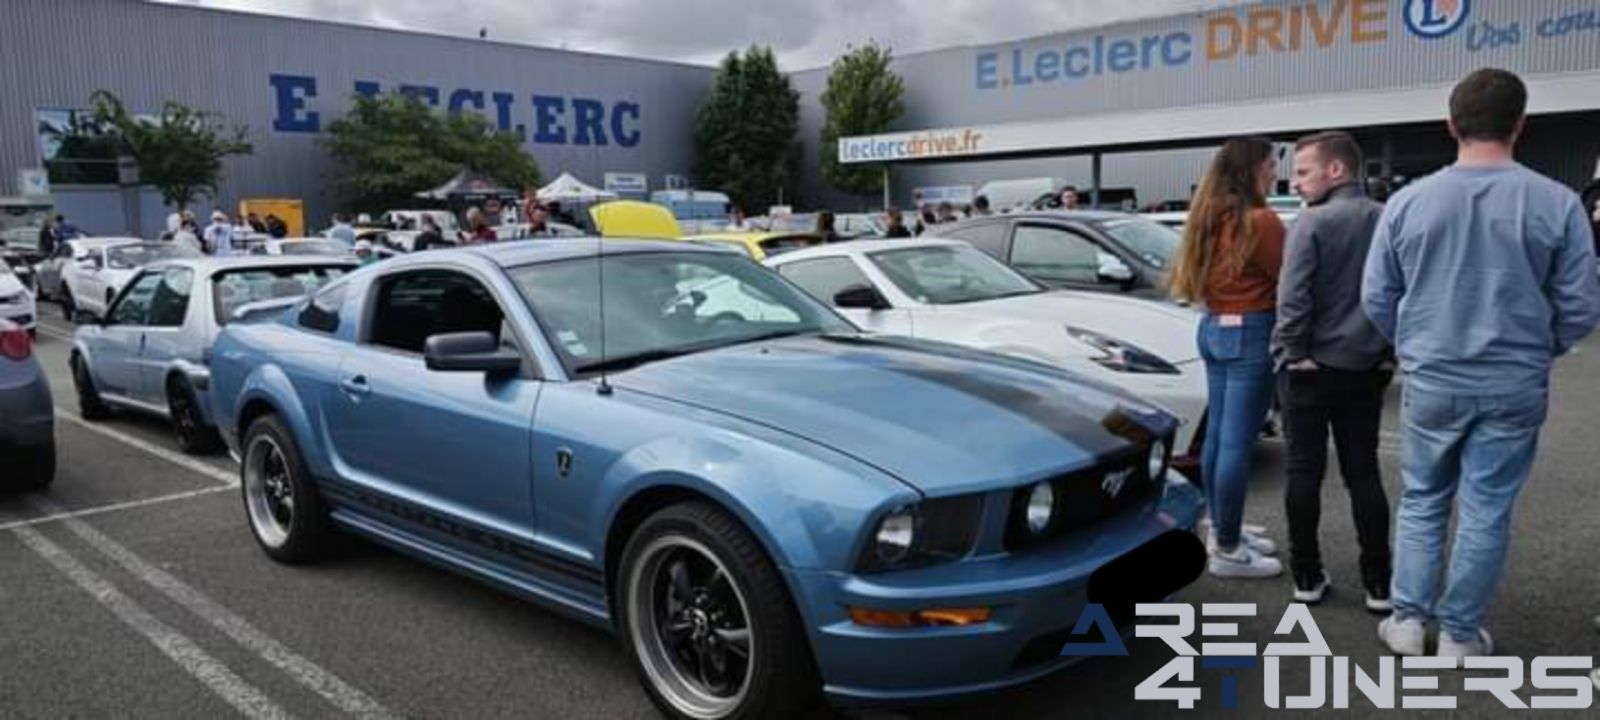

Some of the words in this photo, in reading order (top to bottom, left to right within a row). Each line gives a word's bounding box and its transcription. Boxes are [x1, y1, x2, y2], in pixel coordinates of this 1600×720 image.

[976, 30, 1192, 89] E.Leclerc
[1207, 0, 1387, 60] DRIVE
[842, 128, 983, 161] leclercdrive.fr
